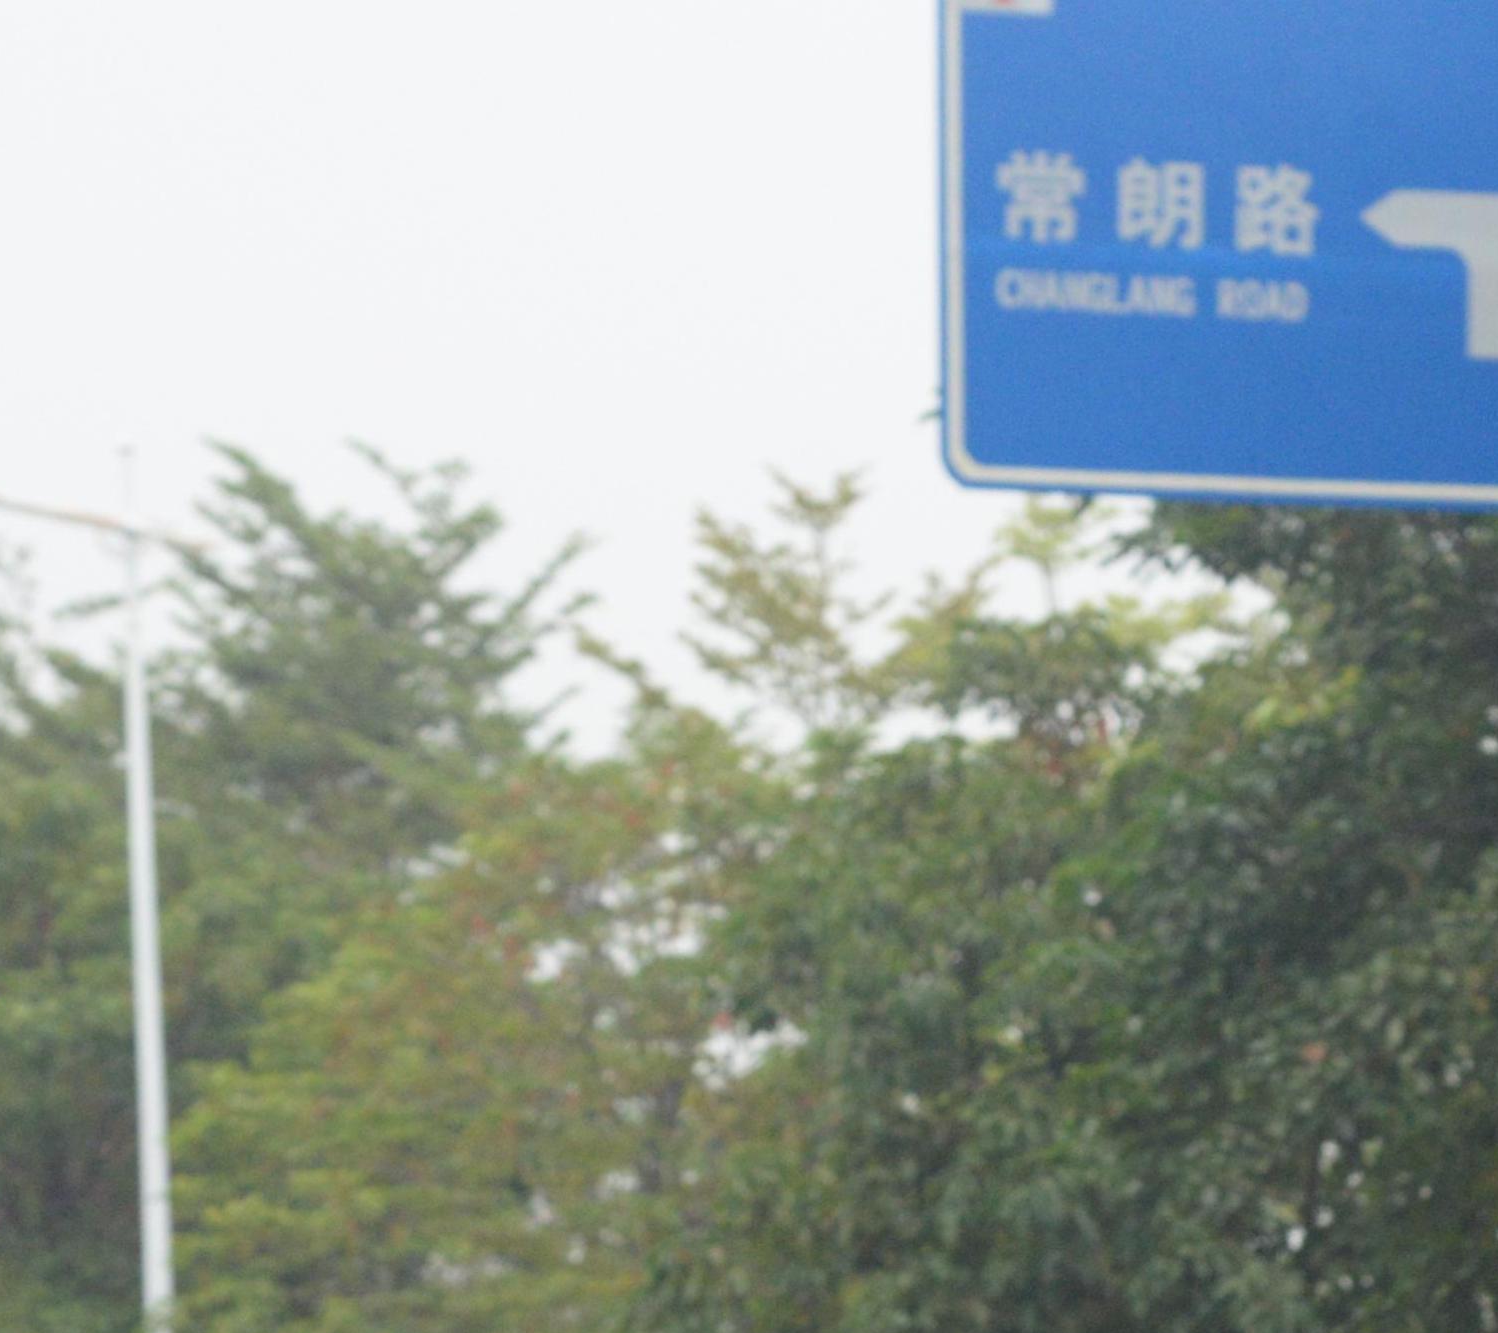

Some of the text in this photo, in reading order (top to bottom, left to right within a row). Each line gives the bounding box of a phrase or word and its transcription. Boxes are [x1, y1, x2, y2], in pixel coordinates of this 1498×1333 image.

[996, 148, 1318, 256] 常朗路
[996, 267, 1310, 322] CHANGLANG ROAD
